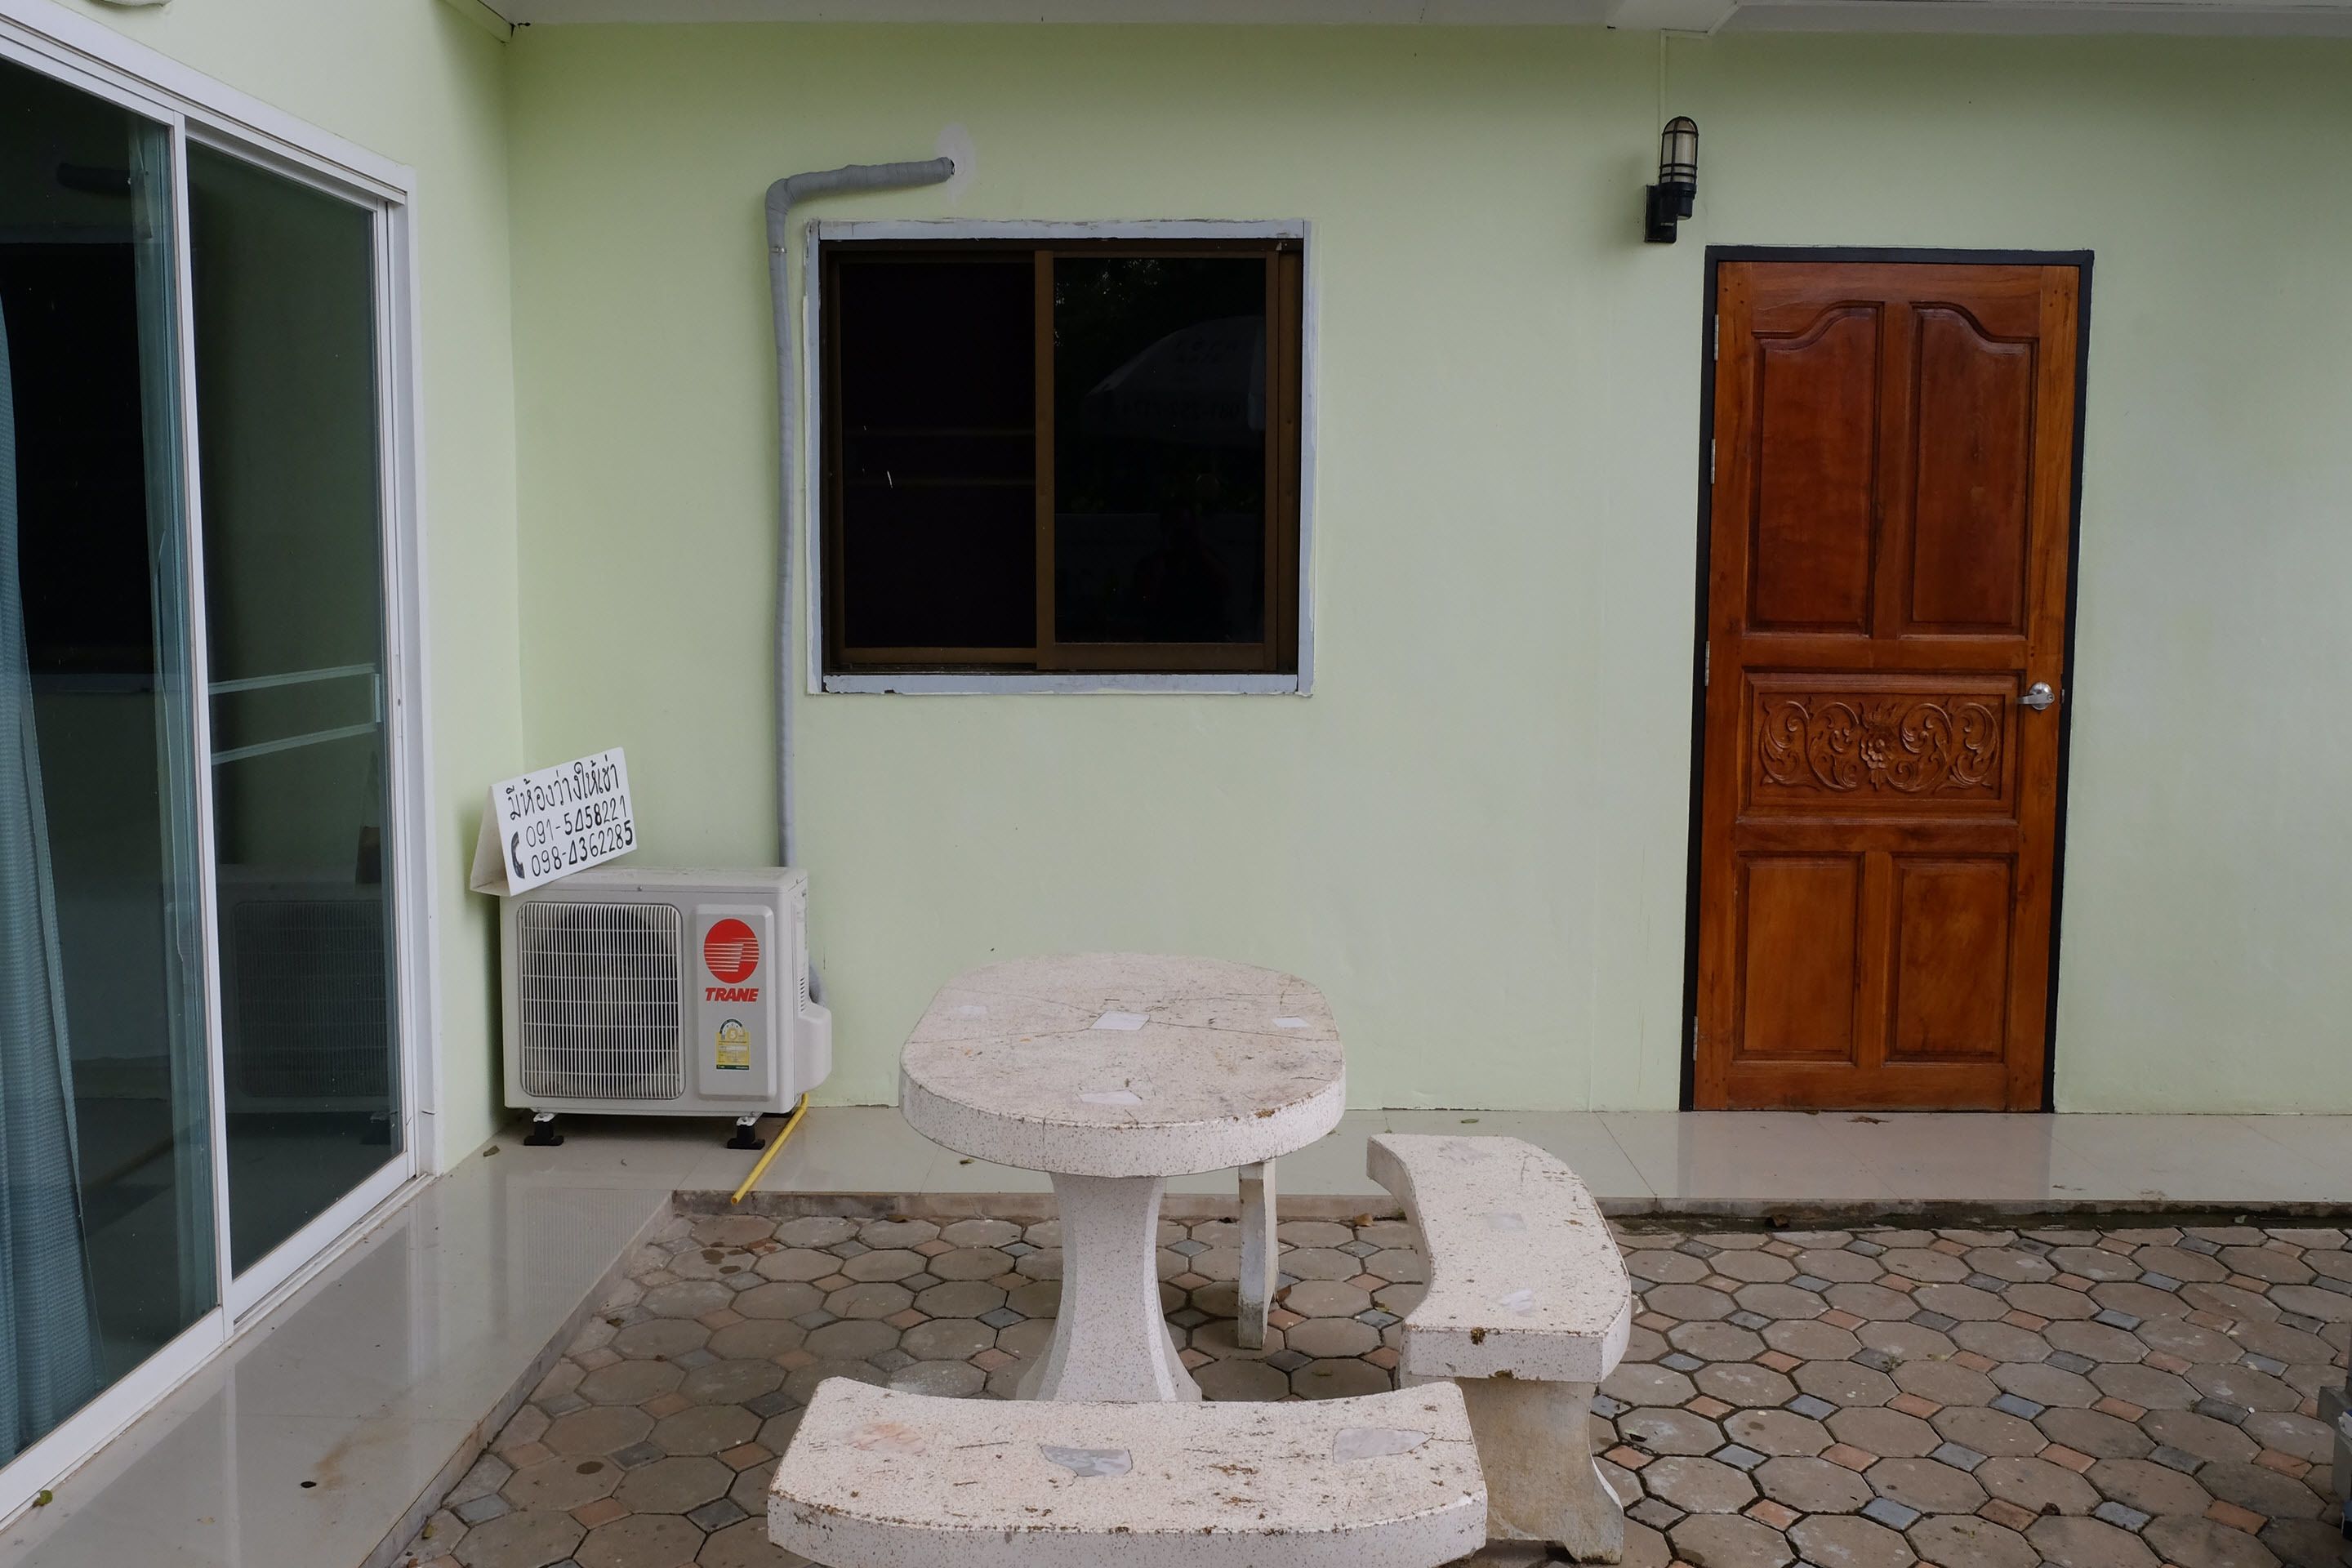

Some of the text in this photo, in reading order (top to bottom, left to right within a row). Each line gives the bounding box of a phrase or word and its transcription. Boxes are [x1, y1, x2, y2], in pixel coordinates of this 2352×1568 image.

[506, 755, 619, 820] มีห้องว่างให้เช่า
[525, 795, 627, 848] 091-5458221
[531, 820, 633, 876] 098-4362285
[706, 987, 760, 1002] TRANE
